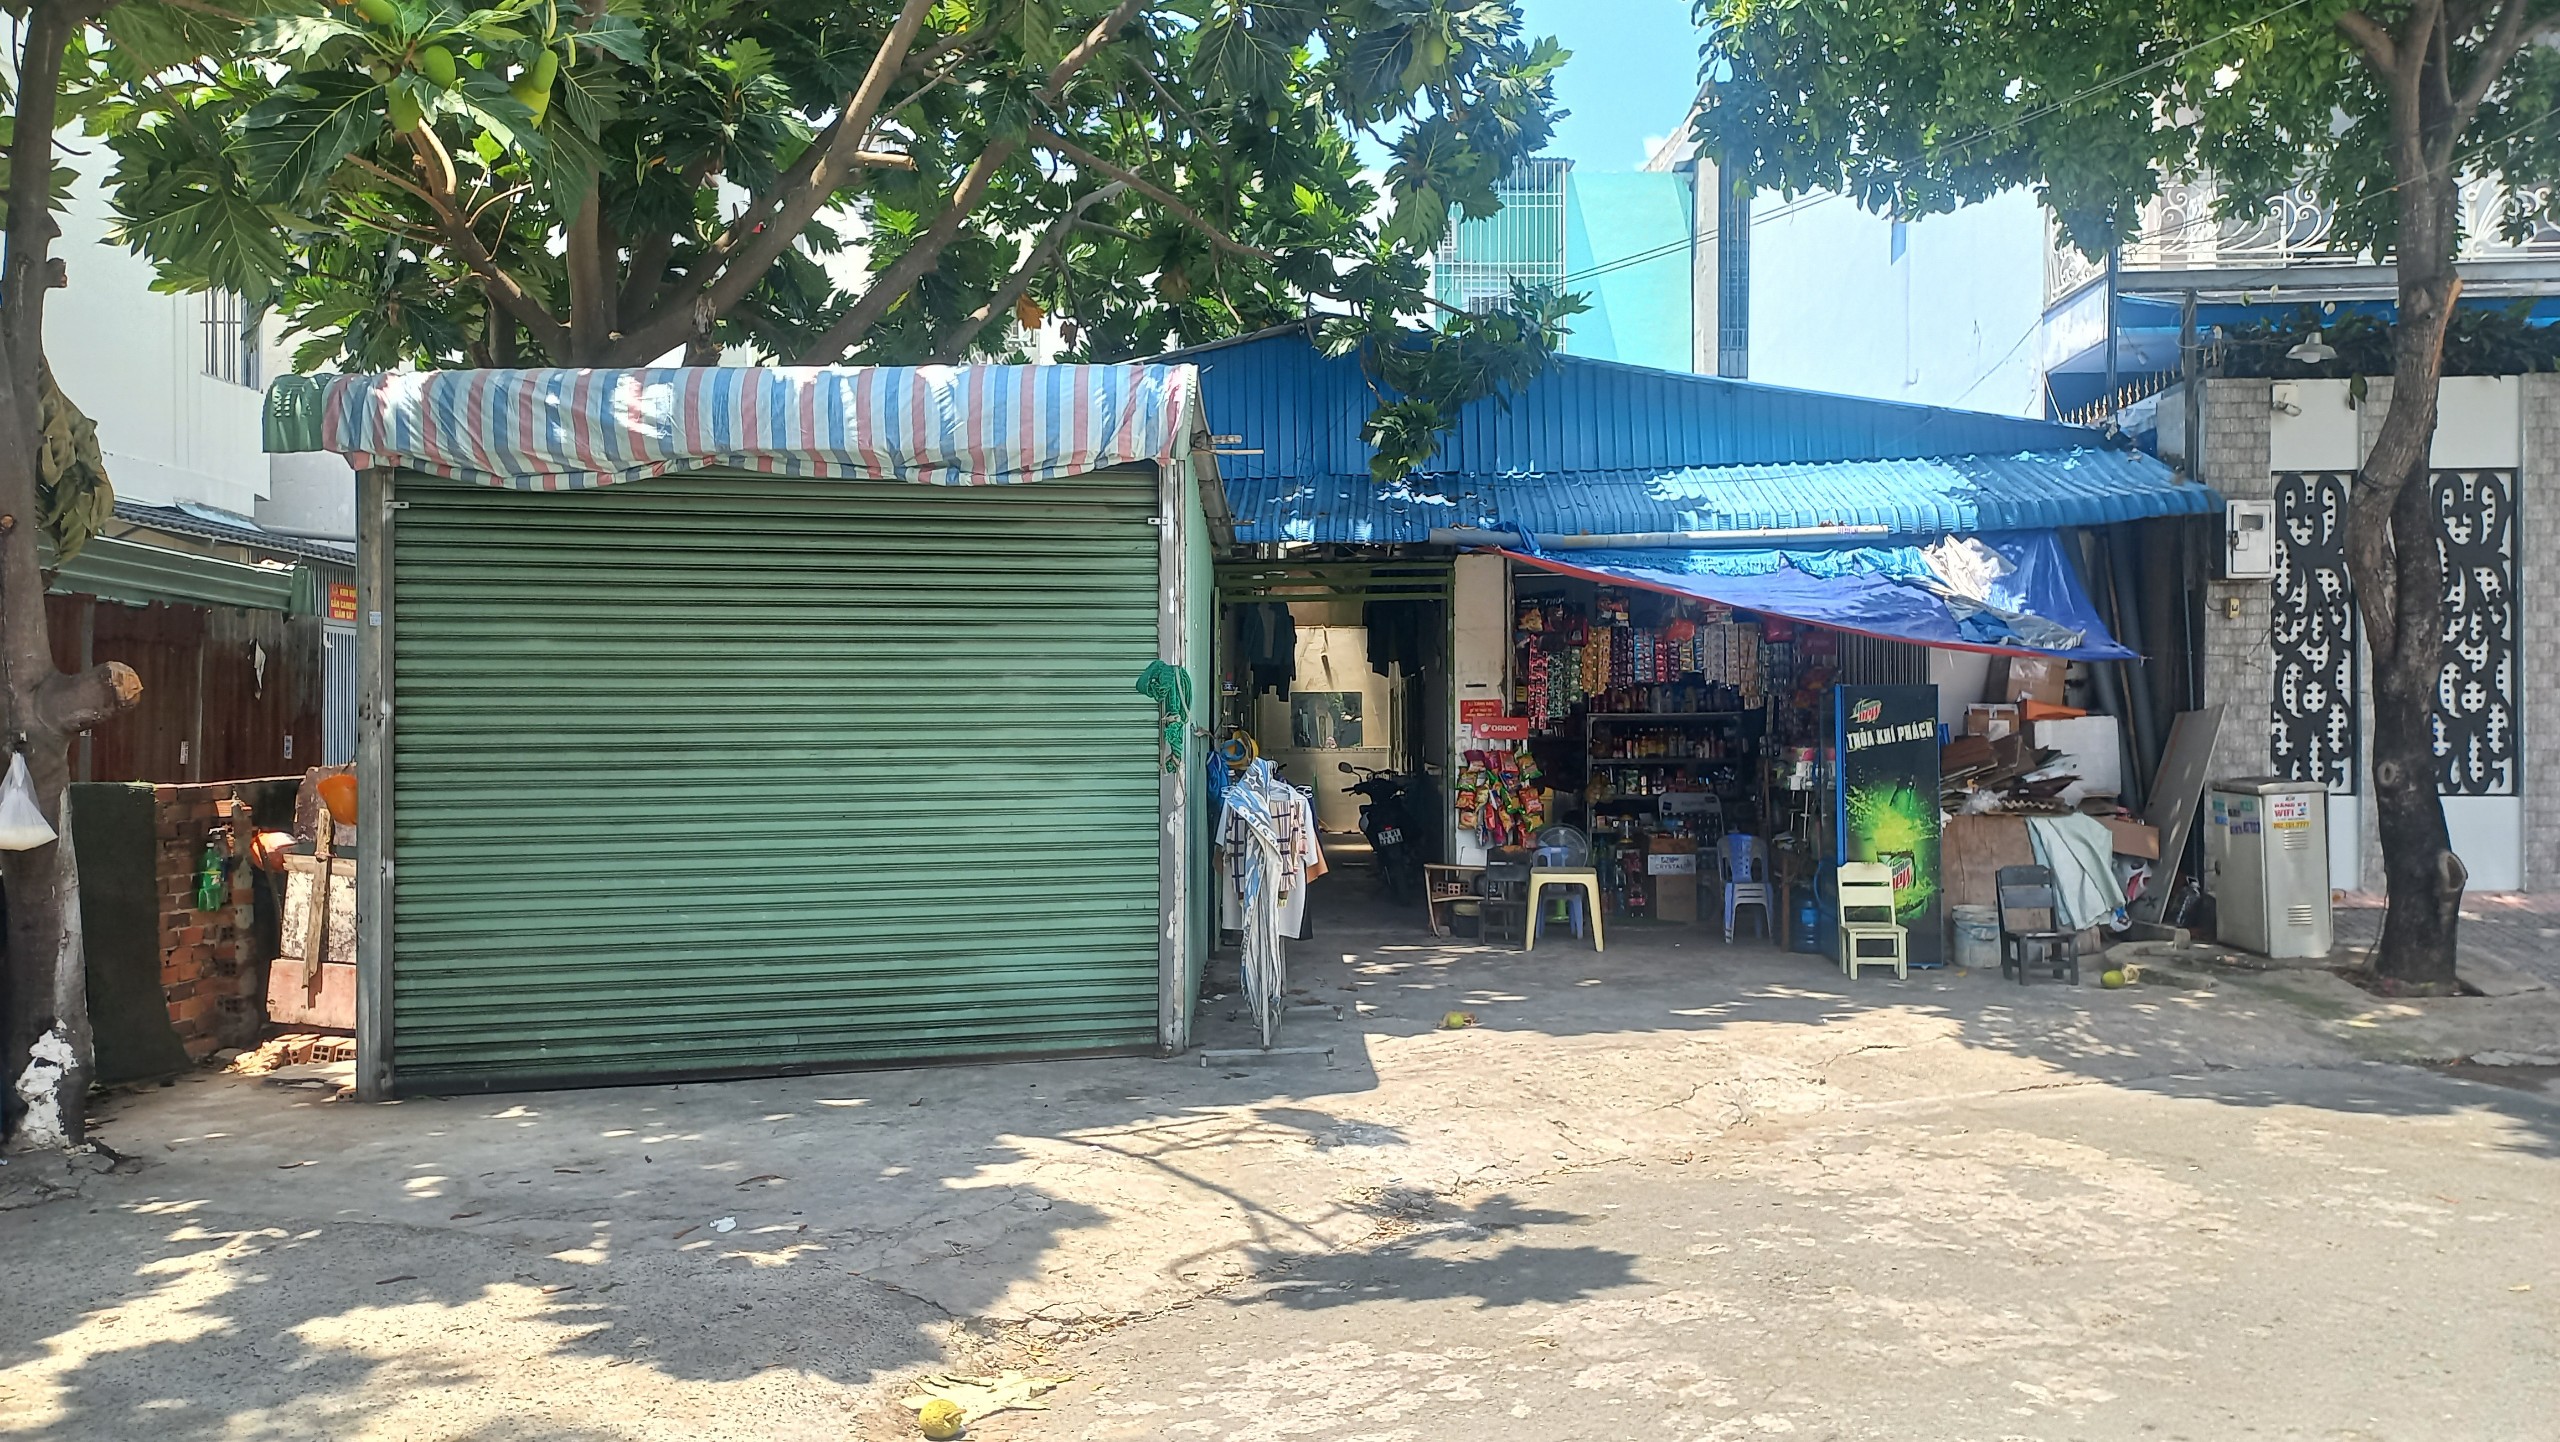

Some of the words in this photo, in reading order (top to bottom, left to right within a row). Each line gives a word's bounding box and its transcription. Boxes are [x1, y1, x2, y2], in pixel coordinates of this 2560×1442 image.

[1491, 724, 1518, 732] ORION
[1846, 727, 1875, 750] THỎA
[1876, 724, 1896, 745] KHÍ
[1896, 720, 1934, 742] PHÁCH
[2274, 808, 2294, 817] WIFI
